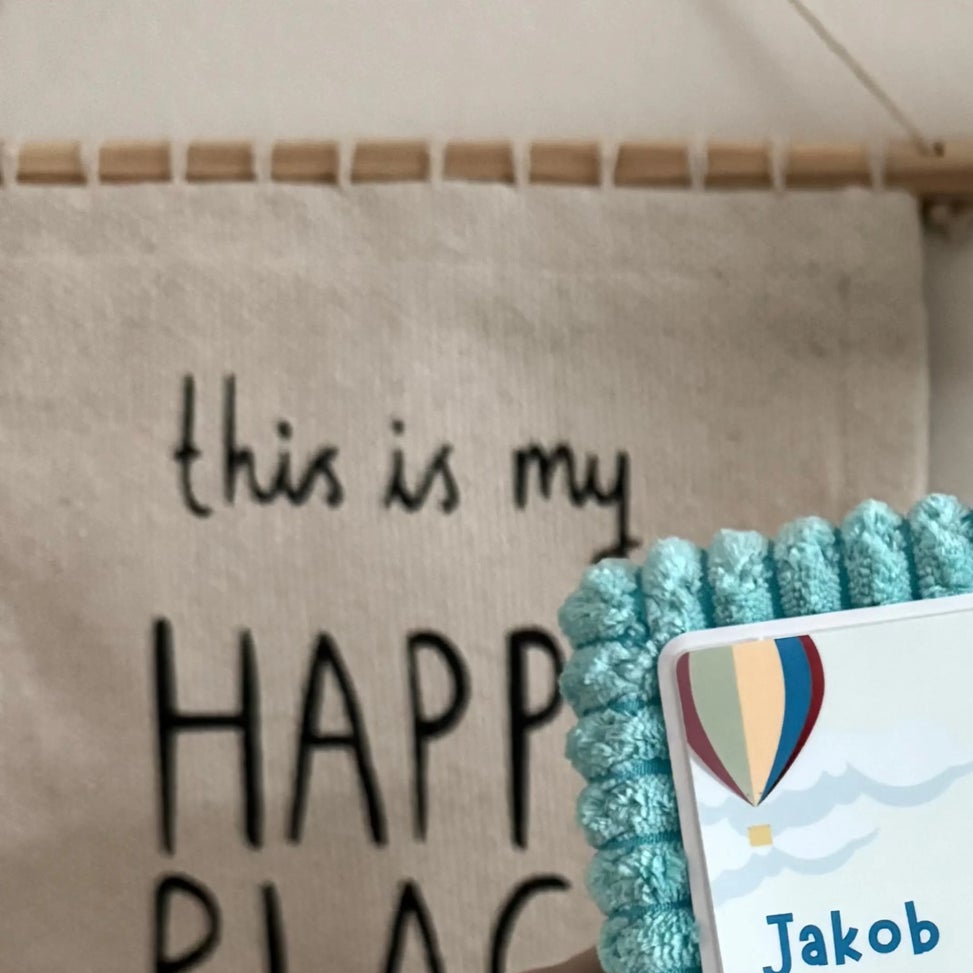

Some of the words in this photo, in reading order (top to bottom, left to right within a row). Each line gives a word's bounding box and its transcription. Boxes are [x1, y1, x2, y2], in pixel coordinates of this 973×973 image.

[173, 372, 343, 517] this
[384, 418, 460, 515] is
[510, 440, 639, 563] my
